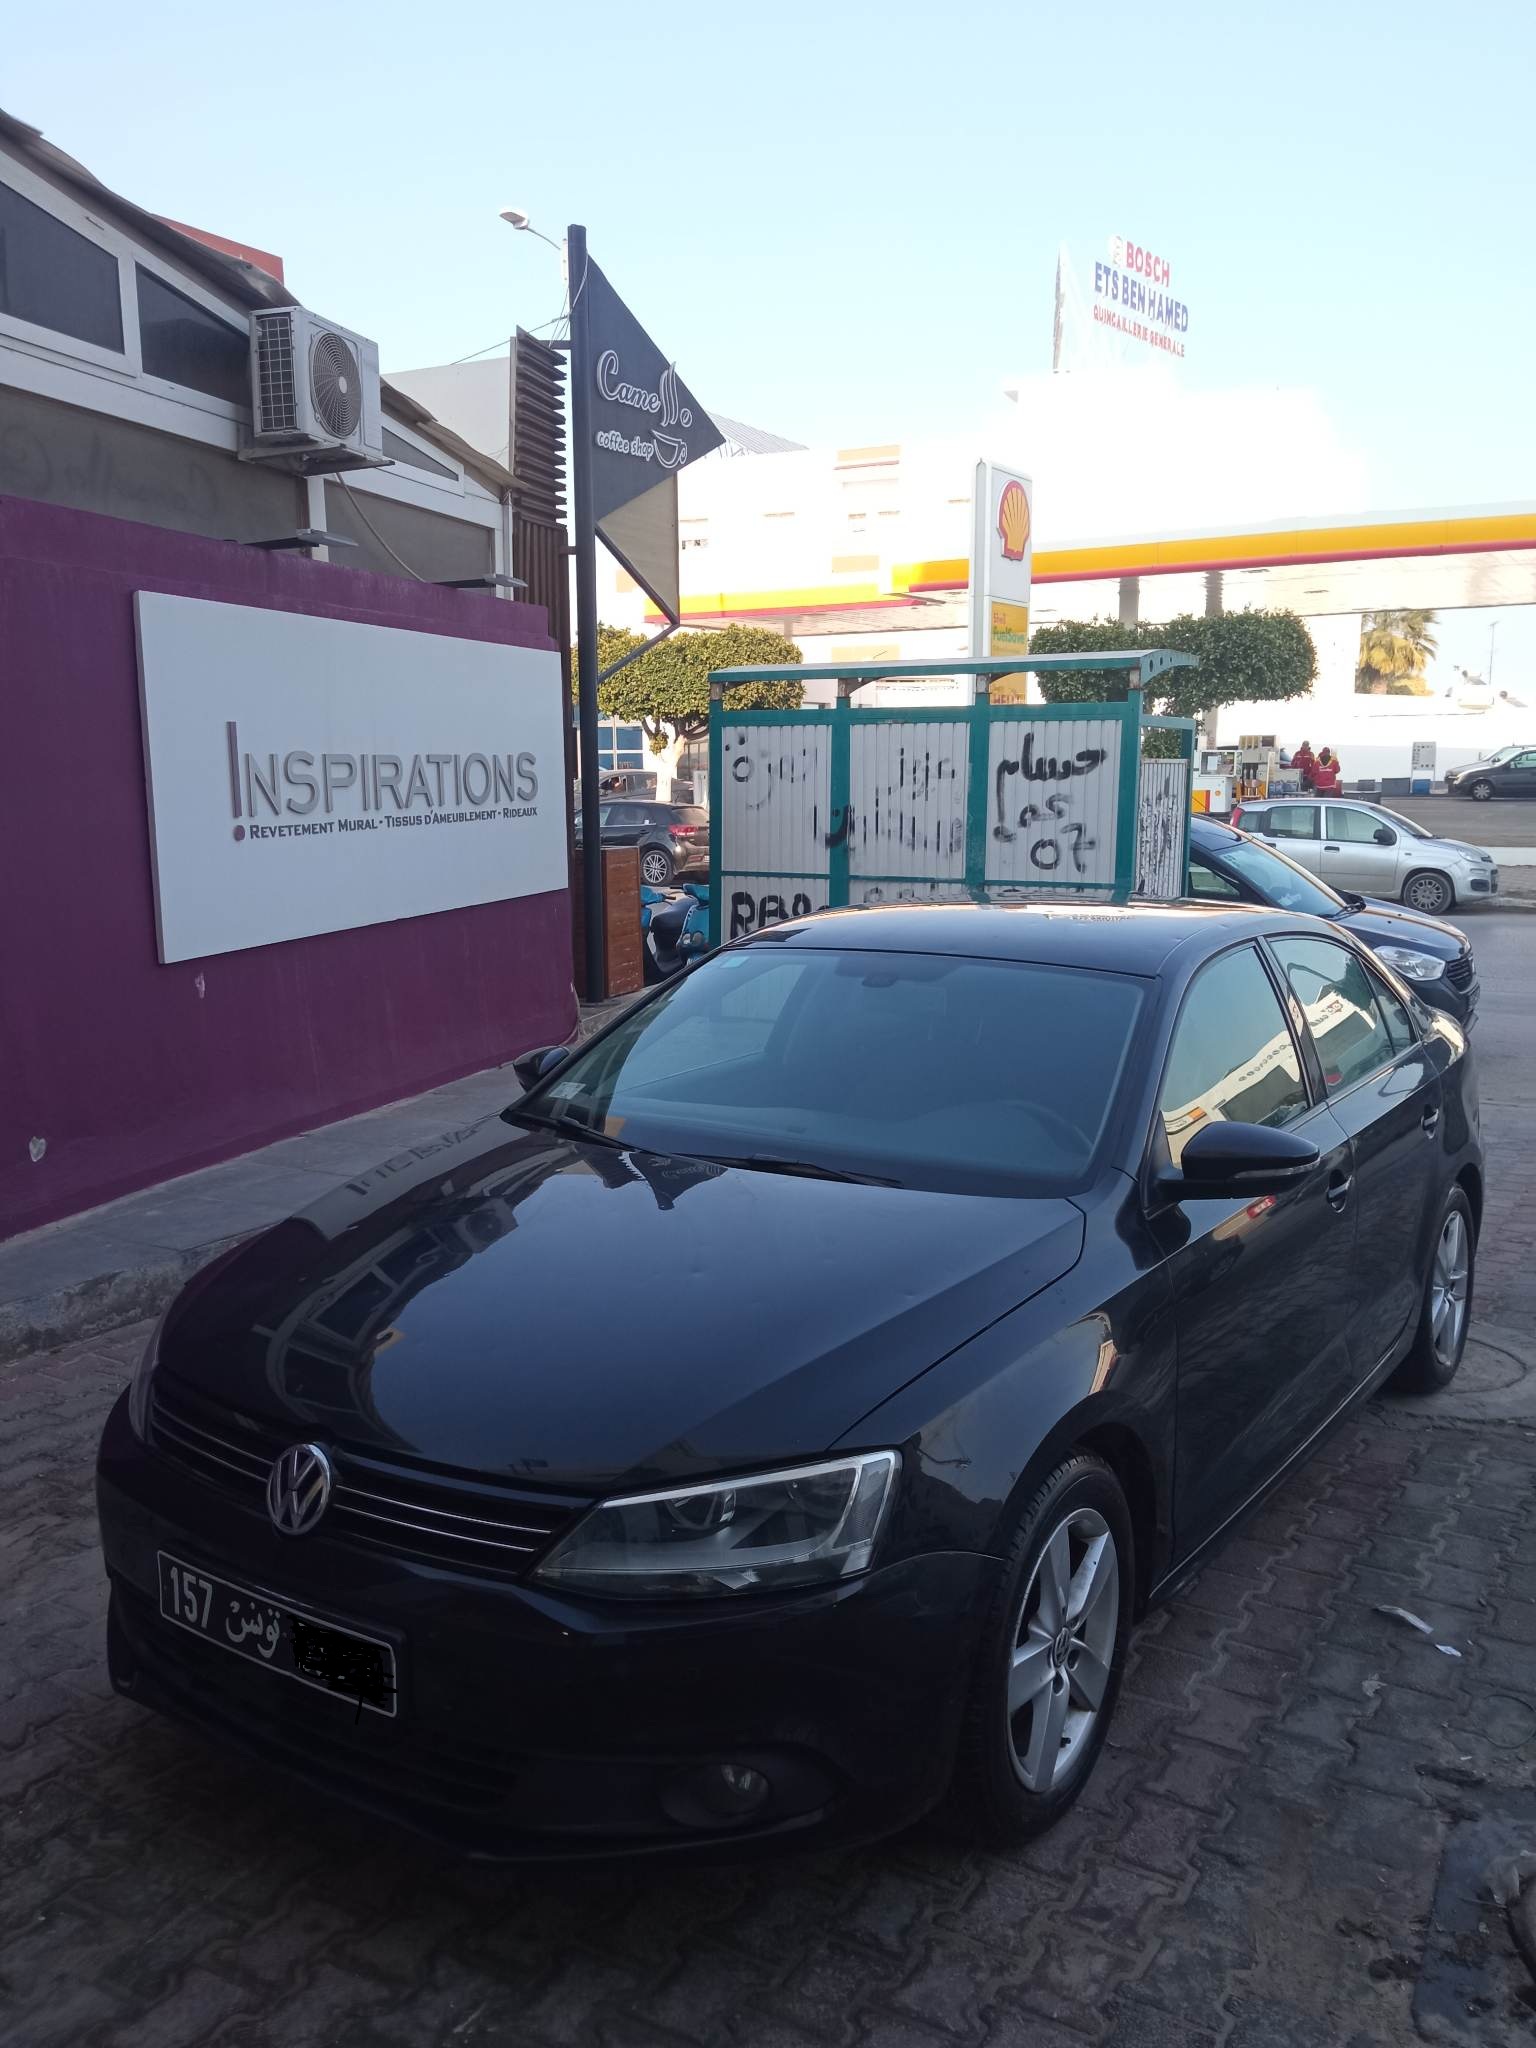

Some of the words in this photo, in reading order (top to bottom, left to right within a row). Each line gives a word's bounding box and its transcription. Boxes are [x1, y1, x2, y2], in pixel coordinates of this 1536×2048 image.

[1126, 241, 1169, 287] BOSCH
[1095, 262, 1119, 300] ETS
[1122, 275, 1145, 313] BEN
[1148, 287, 1188, 332] HAMED
[1093, 304, 1148, 341] QUINCAILLERIE
[1150, 331, 1184, 357] GENERALE
[596, 429, 630, 454] coffee
[630, 434, 654, 462] shop
[226, 721, 540, 820] INSPIRATIONS
[249, 821, 335, 840] REVETEMENT
[338, 818, 378, 832] MURAL
[384, 815, 423, 829] TISSUS
[502, 806, 538, 819] RIDEAUX
[170, 1566, 213, 1630] 157
[225, 1601, 281, 1660] تونس
